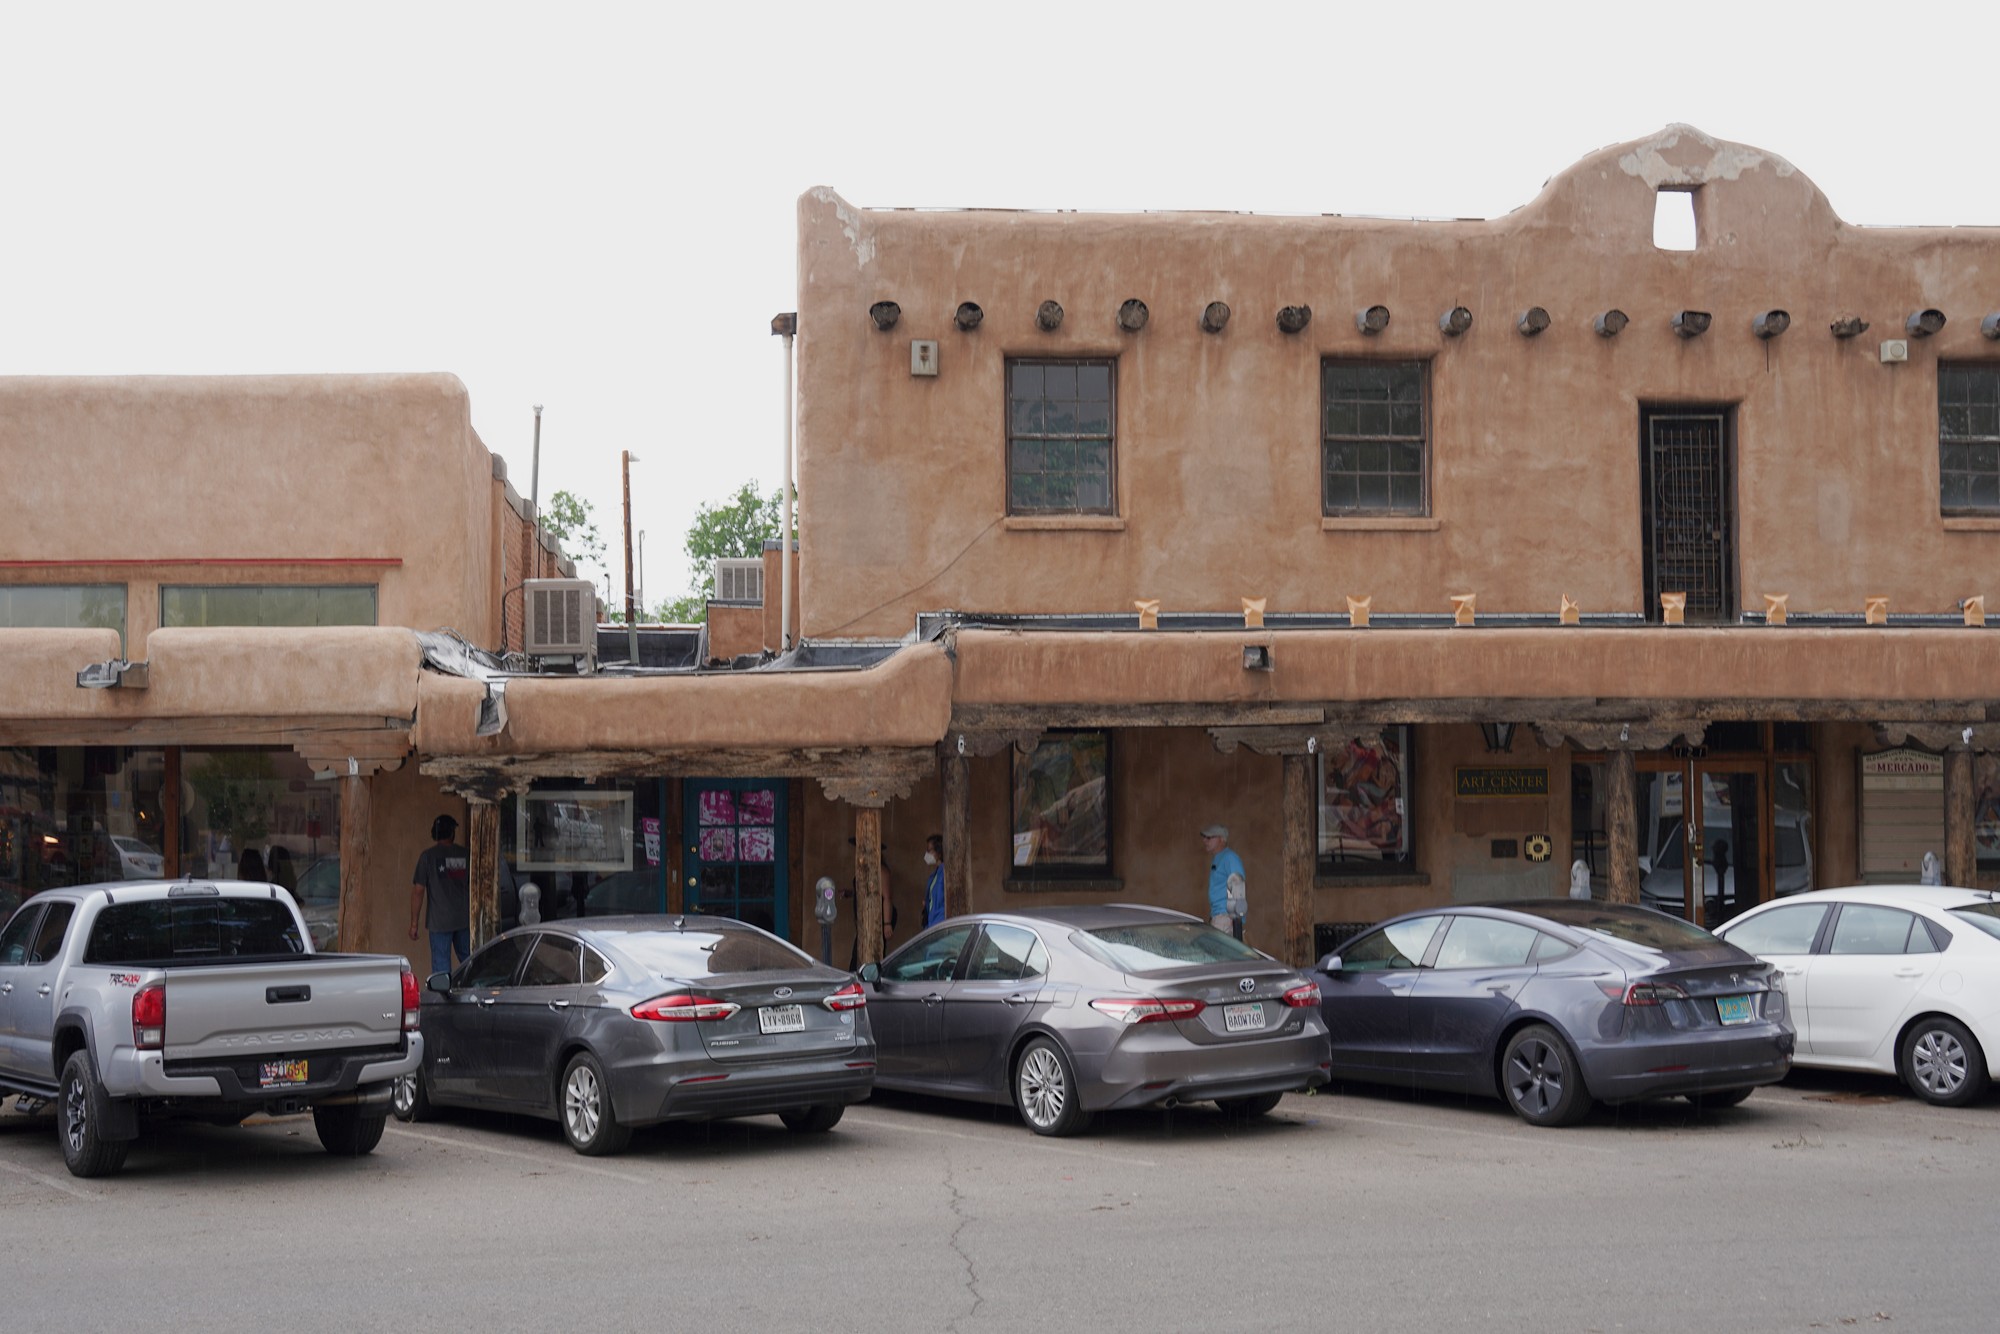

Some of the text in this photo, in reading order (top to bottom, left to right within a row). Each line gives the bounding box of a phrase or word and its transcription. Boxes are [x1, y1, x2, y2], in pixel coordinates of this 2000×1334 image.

[1877, 763, 1929, 773] MERCADO
[1461, 775, 1543, 788] ART CENTER
[219, 1028, 355, 1047] TACOMA
